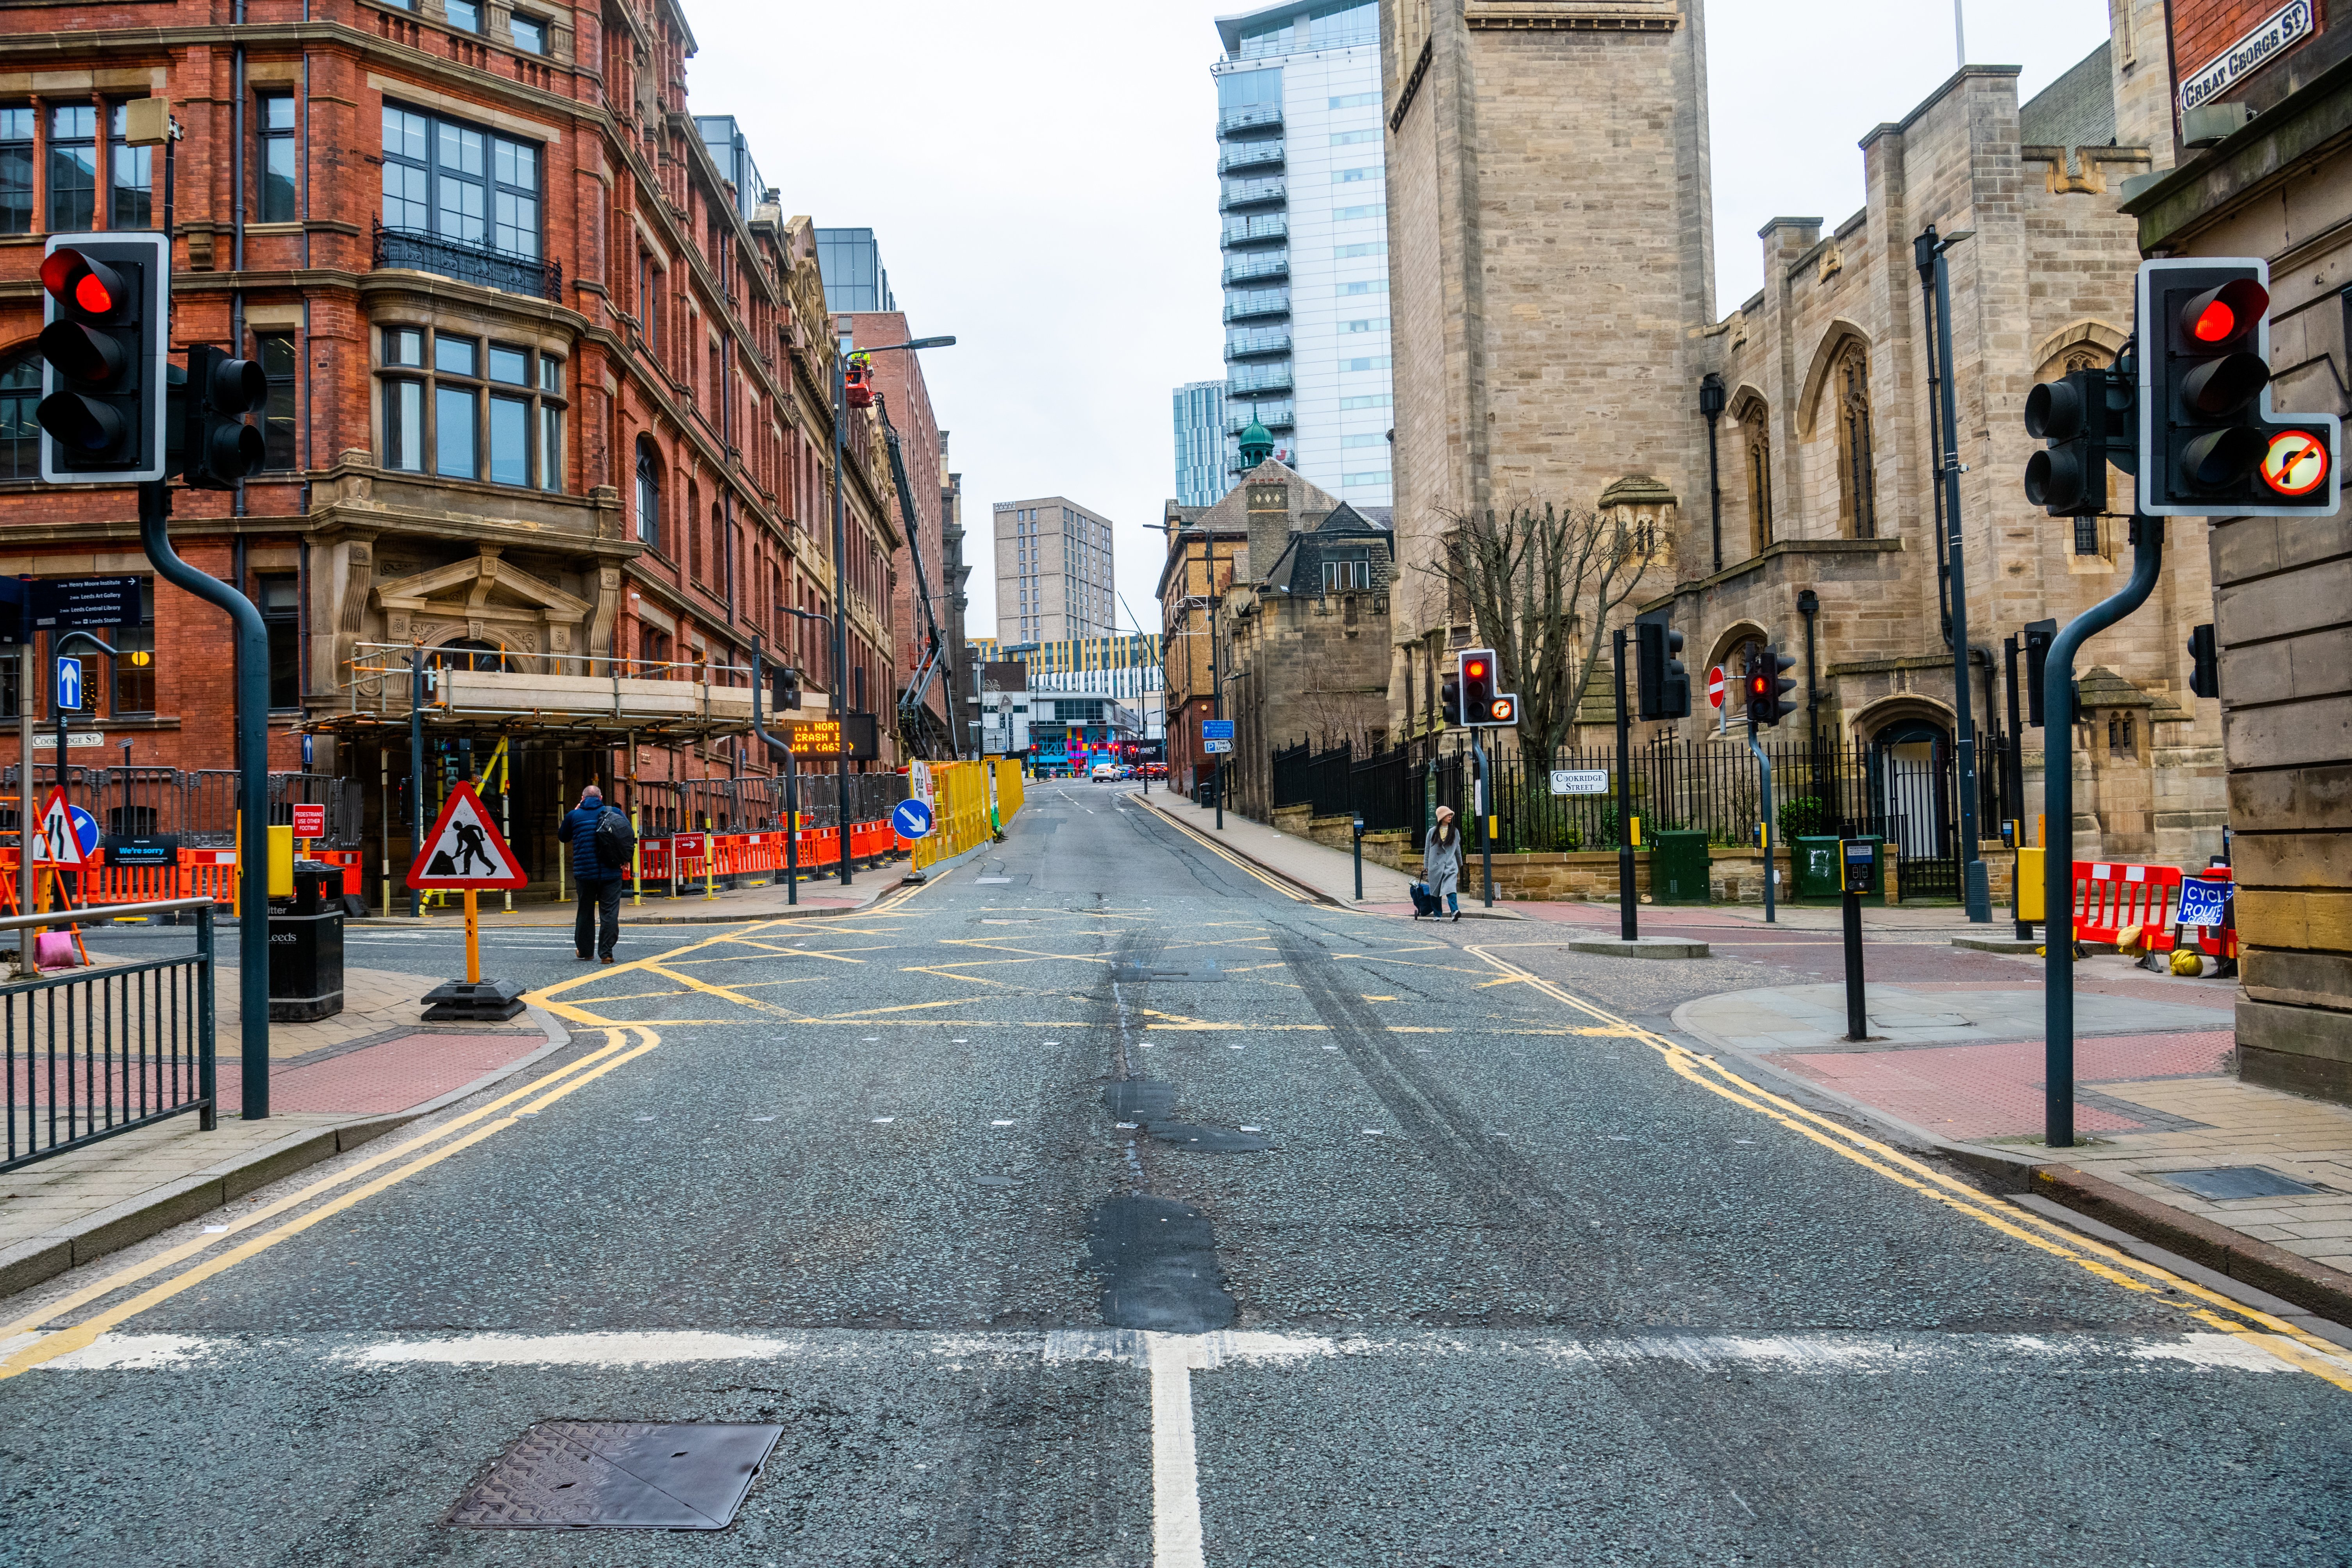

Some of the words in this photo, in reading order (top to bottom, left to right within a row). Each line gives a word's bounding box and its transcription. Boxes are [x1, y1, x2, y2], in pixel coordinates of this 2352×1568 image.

[2186, 66, 2226, 107] GREAT
[2229, 29, 2279, 77] GEORGE
[814, 723, 839, 731] NORT
[34, 737, 82, 745] COOKDGE
[795, 733, 828, 741] CRASH
[789, 743, 808, 752] J44
[816, 743, 854, 752] (A63)
[1556, 773, 1603, 782] COOKRIDGE
[1566, 782, 1593, 791] STREET
[2183, 903, 2222, 918] ROUTE
[2188, 916, 2217, 924] CLOSED
[555, 1457, 612, 1486] STANTON
[498, 1472, 558, 1507] CHIEFTAIN
